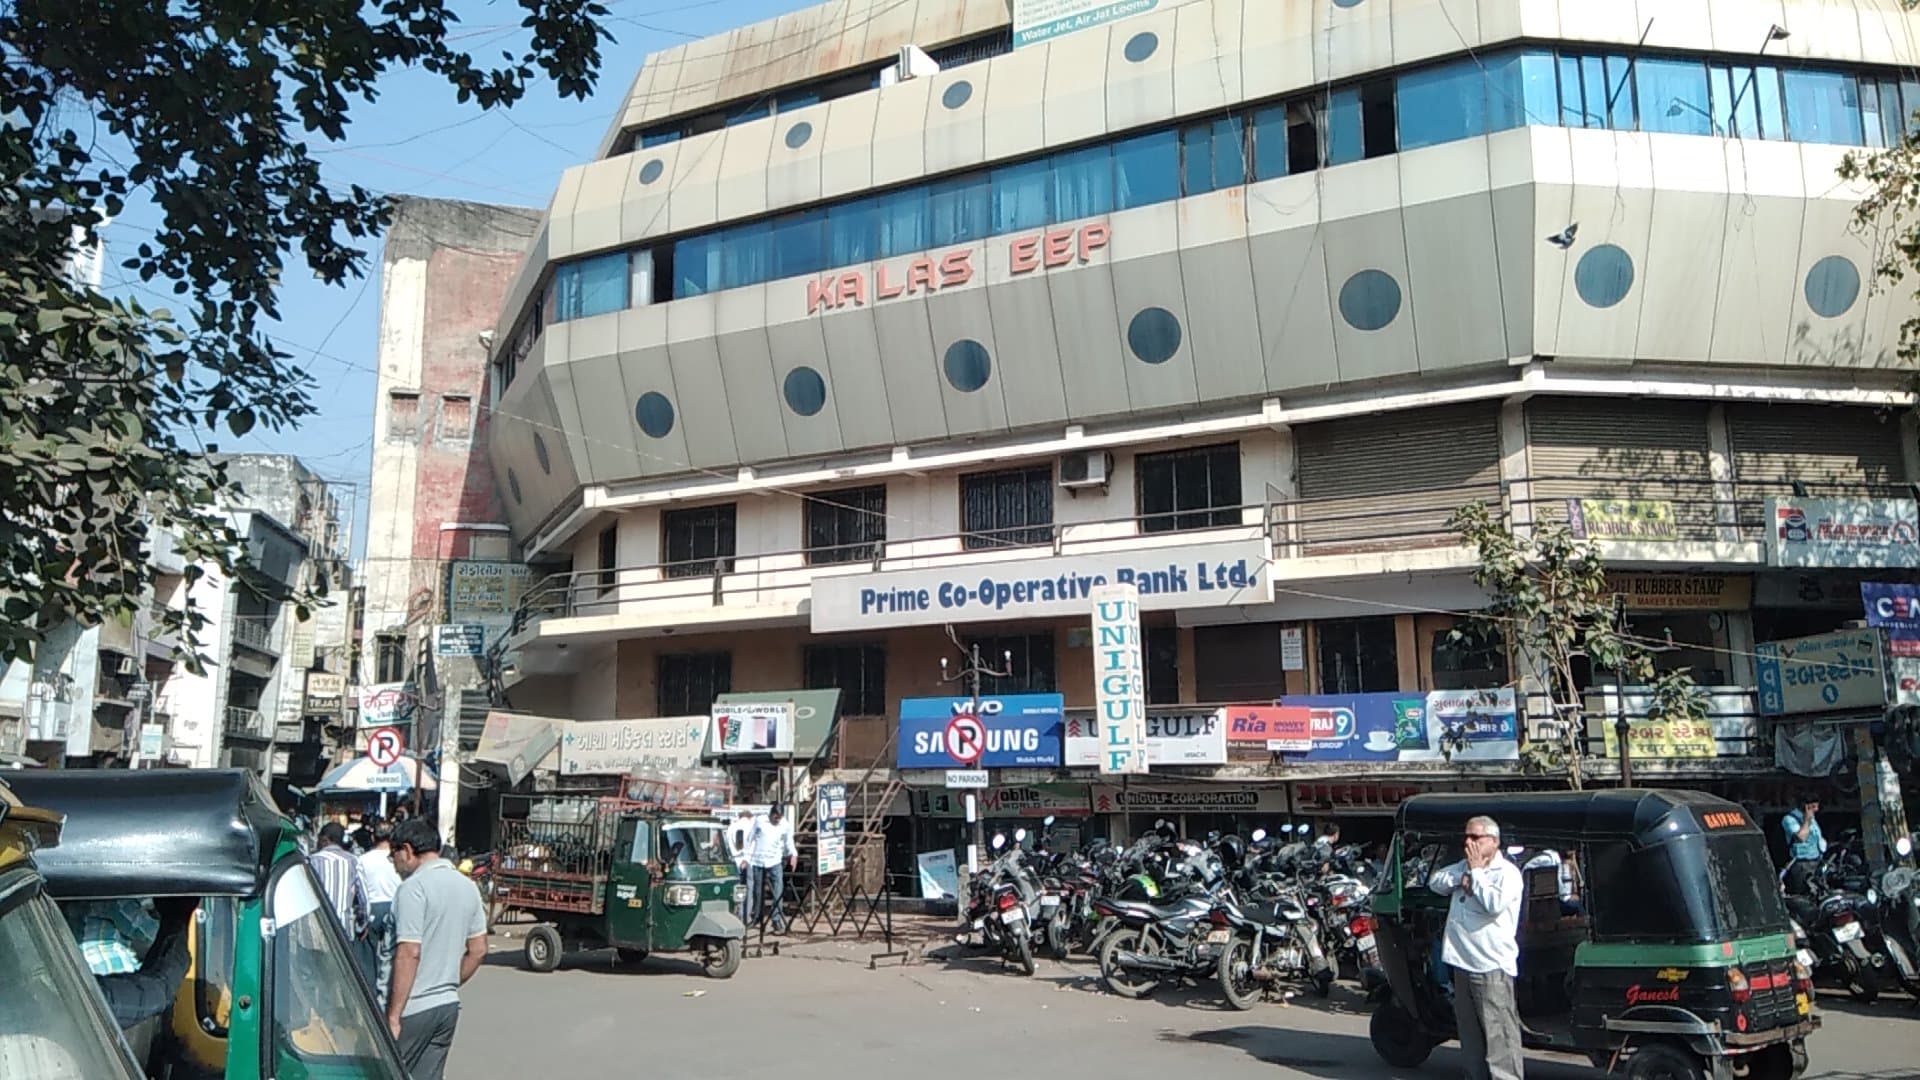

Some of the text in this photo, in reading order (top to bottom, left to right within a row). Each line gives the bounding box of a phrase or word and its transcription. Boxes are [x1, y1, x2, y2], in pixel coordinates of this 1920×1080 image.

[1021, 25, 1052, 43] Water
[1053, 21, 1074, 34] Jet,
[1075, 14, 1092, 27] Air
[1092, 9, 1111, 21] Jet
[1112, 0, 1151, 16] Looms
[1010, 222, 1112, 276] EEP
[1587, 519, 1674, 537] RUBBER STAMP
[861, 587, 929, 615] Prime
[1199, 560, 1257, 591] Ltd.
[1635, 577, 1684, 595] RUBBER
[1685, 576, 1725, 595] STAMP
[1097, 599, 1132, 771] UNIGULF
[1127, 600, 1146, 769] UNIGULF
[715, 706, 788, 714] MOBILE WORLD
[1086, 715, 1220, 738] UGULF
[1232, 712, 1266, 733] Ria
[1336, 715, 1348, 733] 9
[377, 736, 394, 760] P
[914, 728, 1039, 754] SAUNG
[959, 725, 977, 754] P
[366, 774, 400, 784] NO PARKING
[948, 775, 987, 784] NO PARKING
[1120, 791, 1255, 804] UNIGULF CORPORATION
[1625, 983, 1680, 1006] Ganesh
